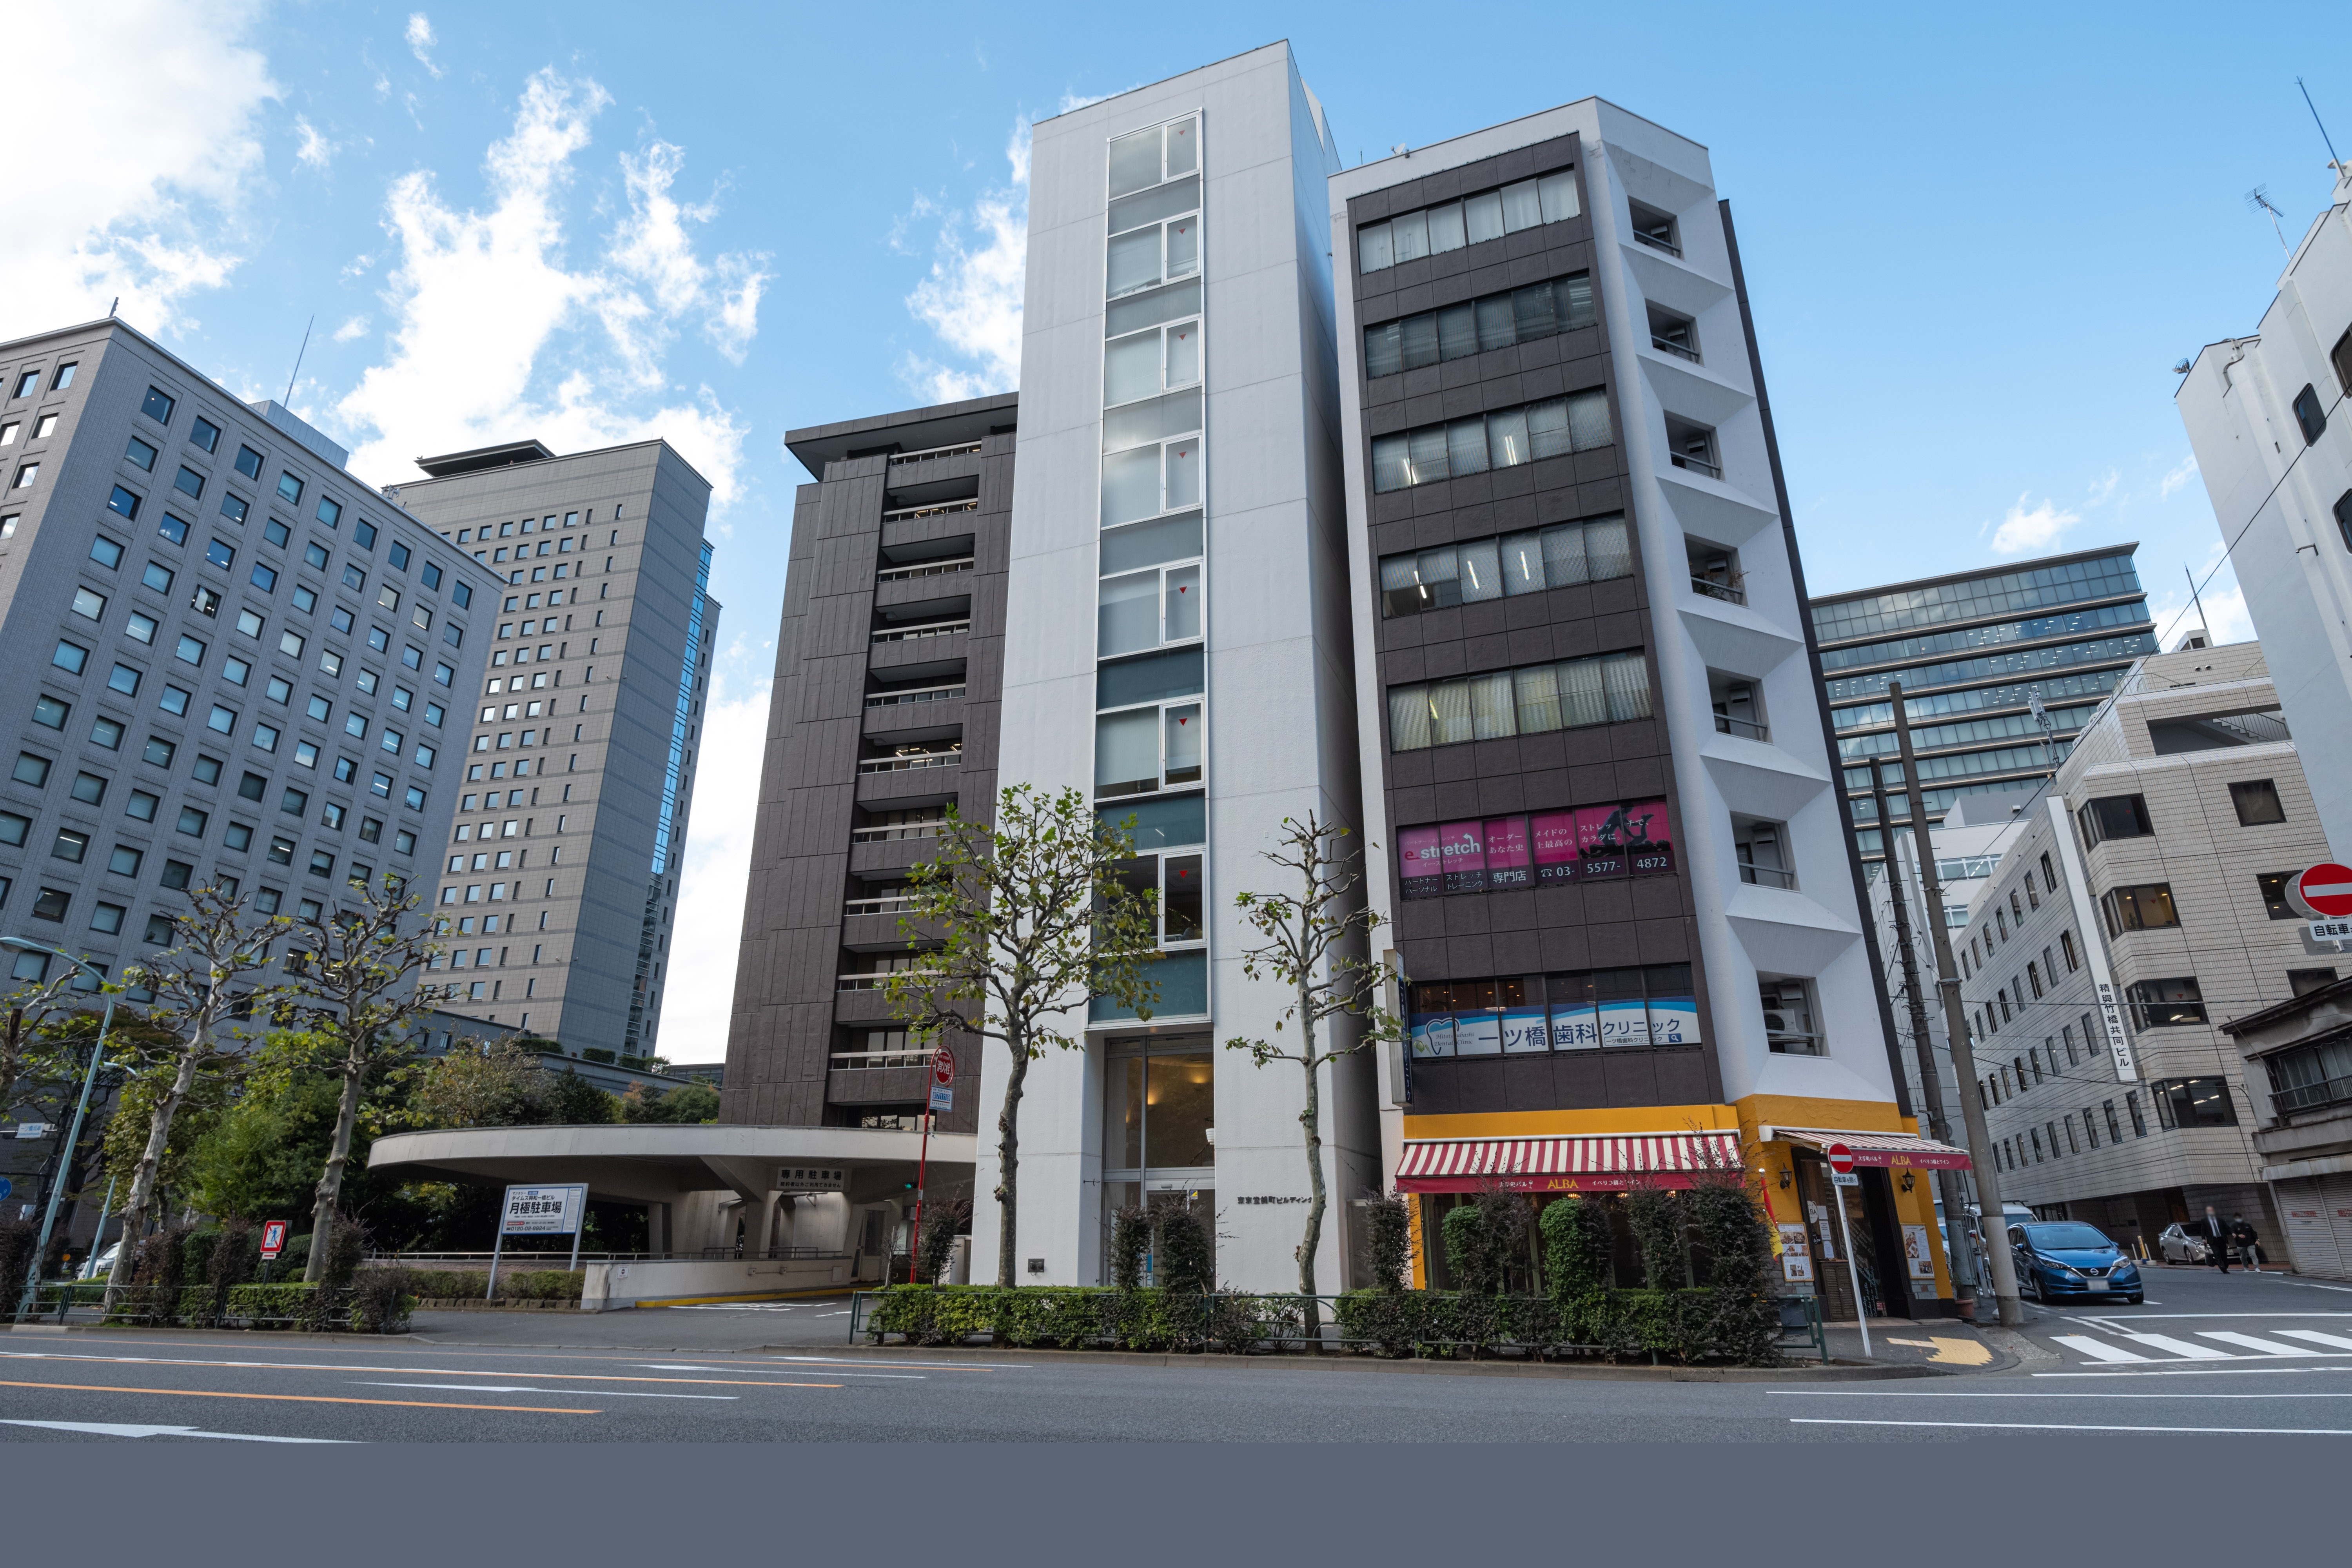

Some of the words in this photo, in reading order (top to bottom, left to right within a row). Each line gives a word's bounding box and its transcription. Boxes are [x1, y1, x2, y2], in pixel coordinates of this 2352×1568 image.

[1421, 833, 1481, 859] stretch
[1557, 866, 1575, 876] 03-
[1587, 862, 1621, 873] 5577-
[1637, 857, 1667, 869] 4872
[1446, 871, 1482, 881] ストレッチ
[1492, 870, 1527, 883] 専門店
[2314, 923, 2352, 936] 自転車
[2099, 984, 2129, 1067] 精興竹橋共同ビル
[936, 1060, 951, 1075] 消火栓
[1891, 1155, 1912, 1166] ALBA
[781, 1169, 842, 1180] 専用駐車場
[1547, 1179, 1579, 1189] ALBA
[509, 1201, 562, 1214] 月極駐車場
